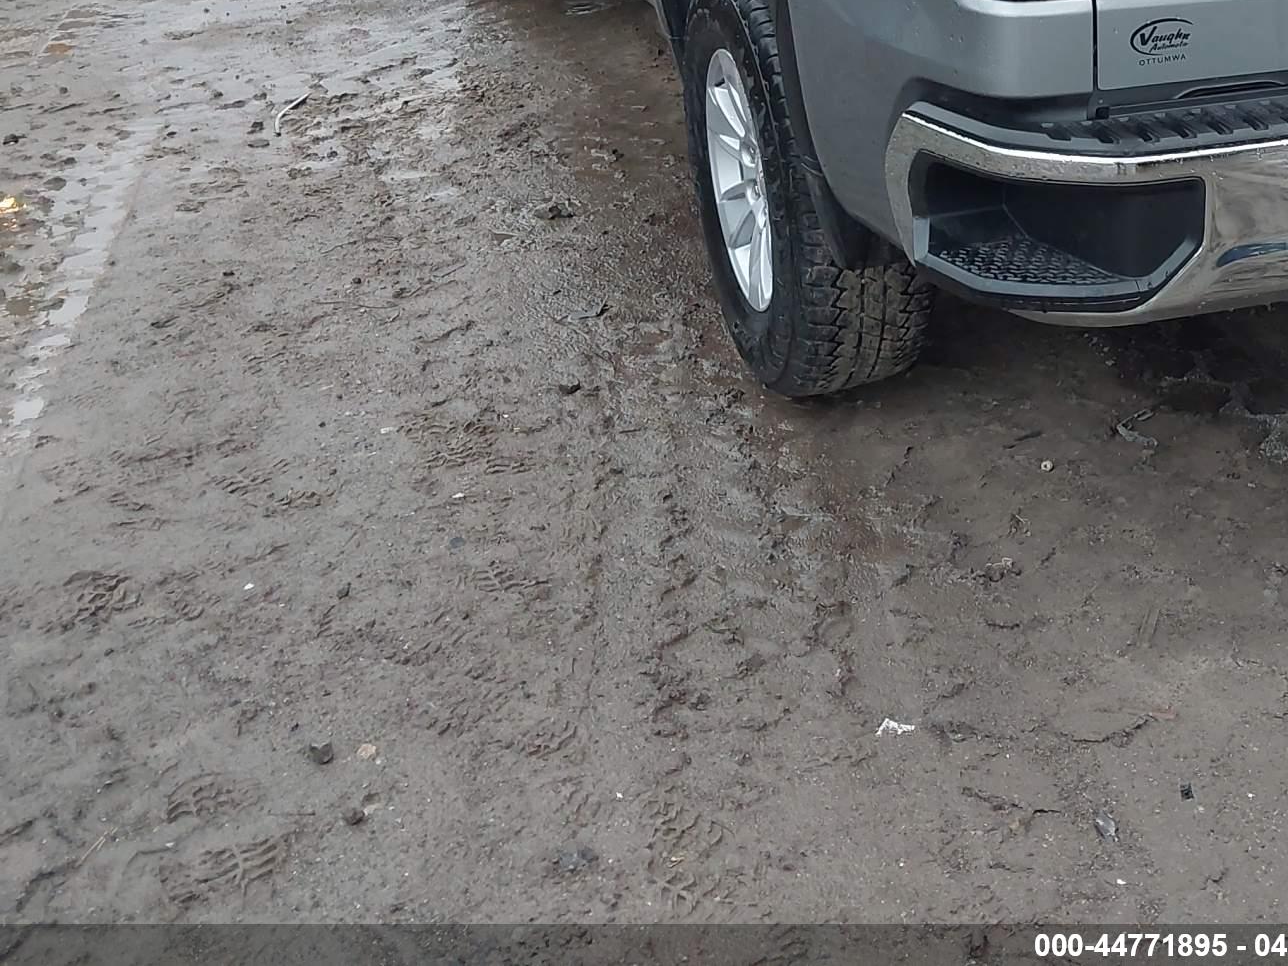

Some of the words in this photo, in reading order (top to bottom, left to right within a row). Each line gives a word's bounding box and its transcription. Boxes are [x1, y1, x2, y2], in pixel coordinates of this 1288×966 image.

[1139, 25, 1191, 47] Vaughn
[1148, 40, 1189, 54] Automot
[1138, 53, 1187, 67] OTTUMWA
